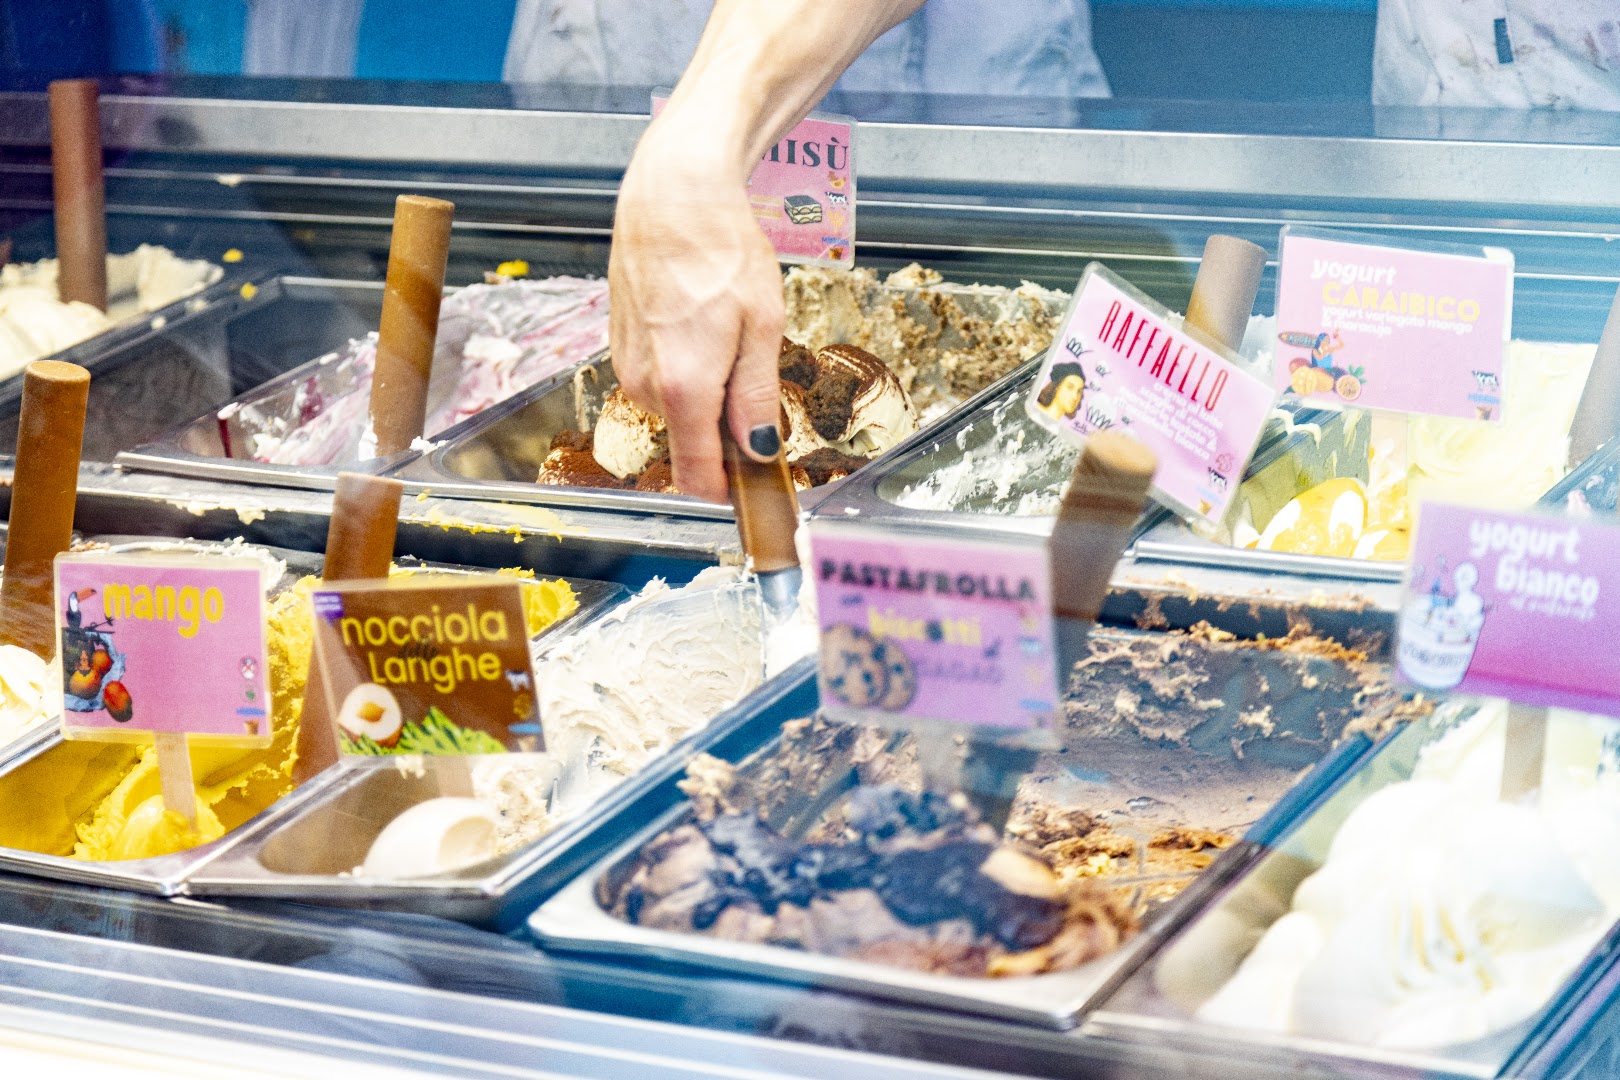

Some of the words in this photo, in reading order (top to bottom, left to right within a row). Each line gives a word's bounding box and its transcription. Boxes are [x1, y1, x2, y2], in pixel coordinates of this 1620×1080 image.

[1310, 259, 1397, 286] yogurt
[1322, 282, 1480, 322] CARAIBICO
[1098, 300, 1229, 412] RAFFAELLO
[1469, 519, 1580, 565] yogurt
[820, 559, 1035, 600] PASTAFROLLA
[1496, 556, 1600, 607] bianco
[103, 583, 224, 638] mango
[341, 603, 509, 646] nocciola
[368, 647, 500, 693] Langhe
